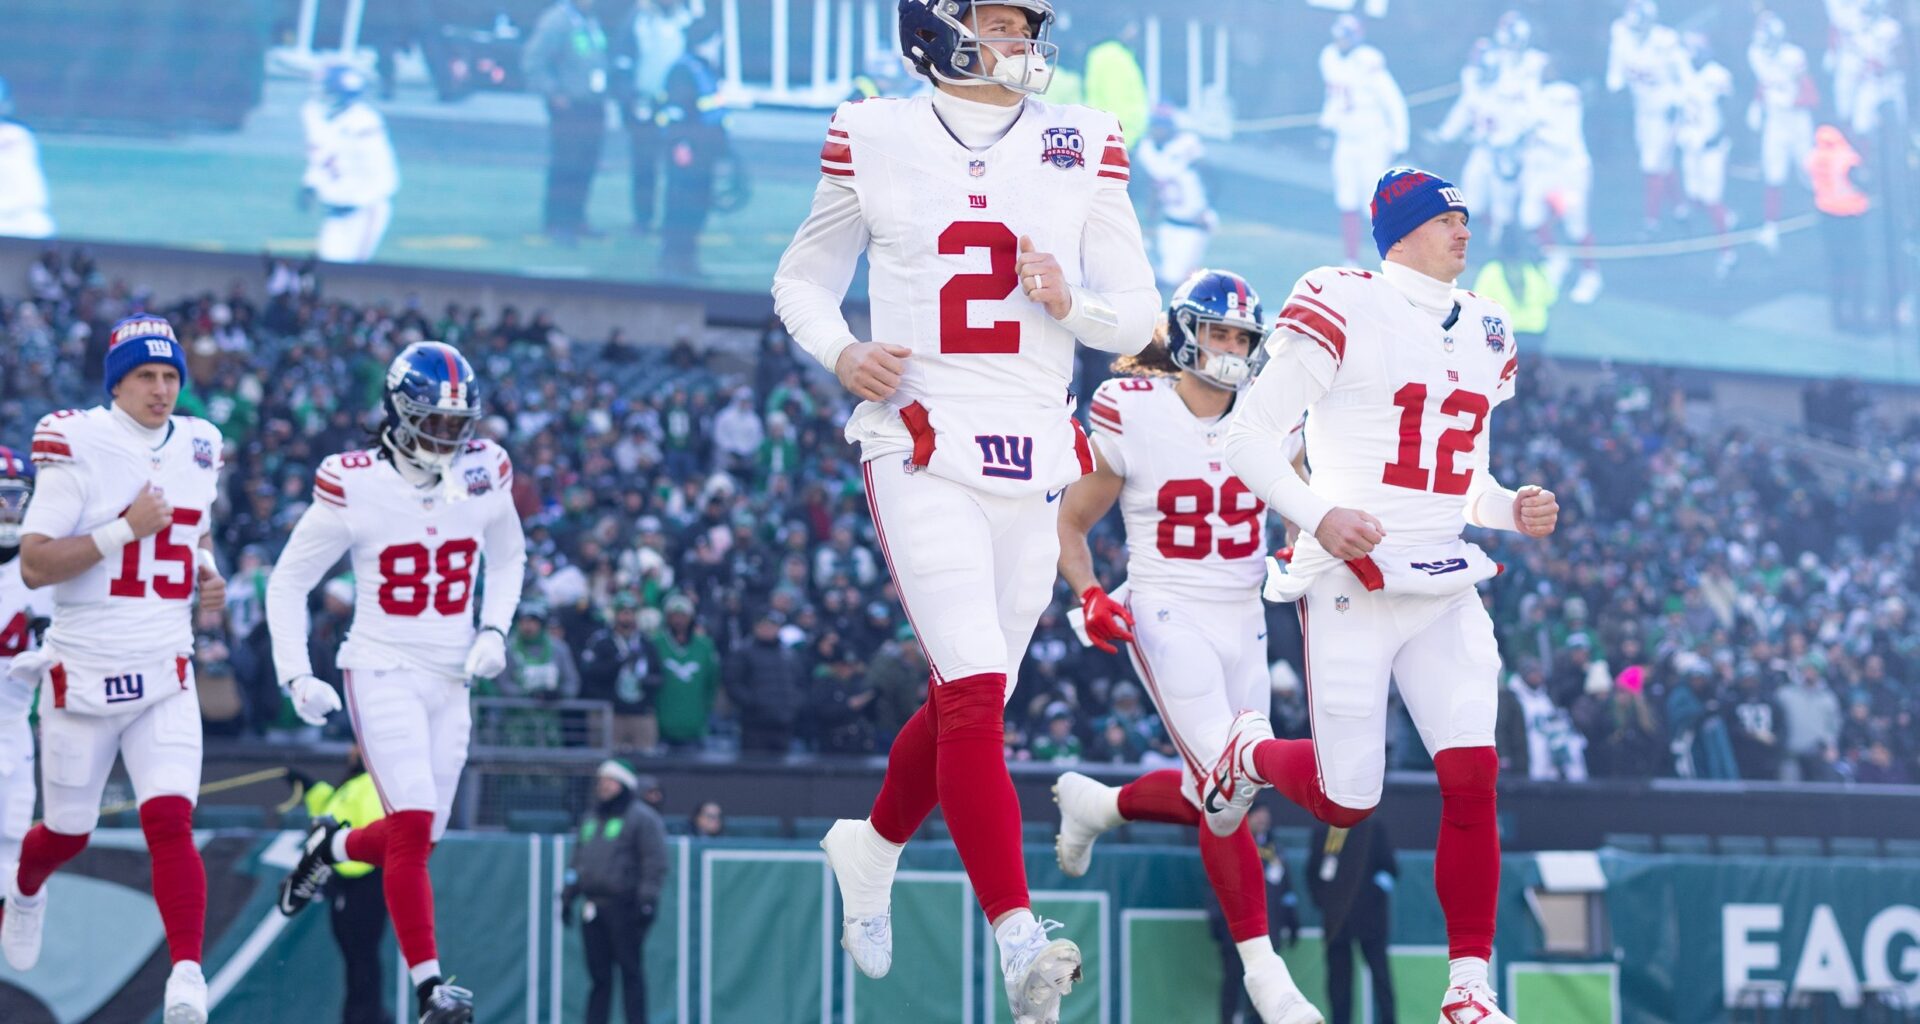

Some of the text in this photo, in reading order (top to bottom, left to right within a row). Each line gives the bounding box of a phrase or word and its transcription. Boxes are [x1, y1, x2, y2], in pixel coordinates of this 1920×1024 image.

[1042, 133, 1084, 153] 100
[938, 221, 1020, 354] 2
[1382, 382, 1490, 495] 12
[109, 504, 203, 600] 15
[1156, 476, 1266, 560] 89
[378, 537, 478, 618] 88
